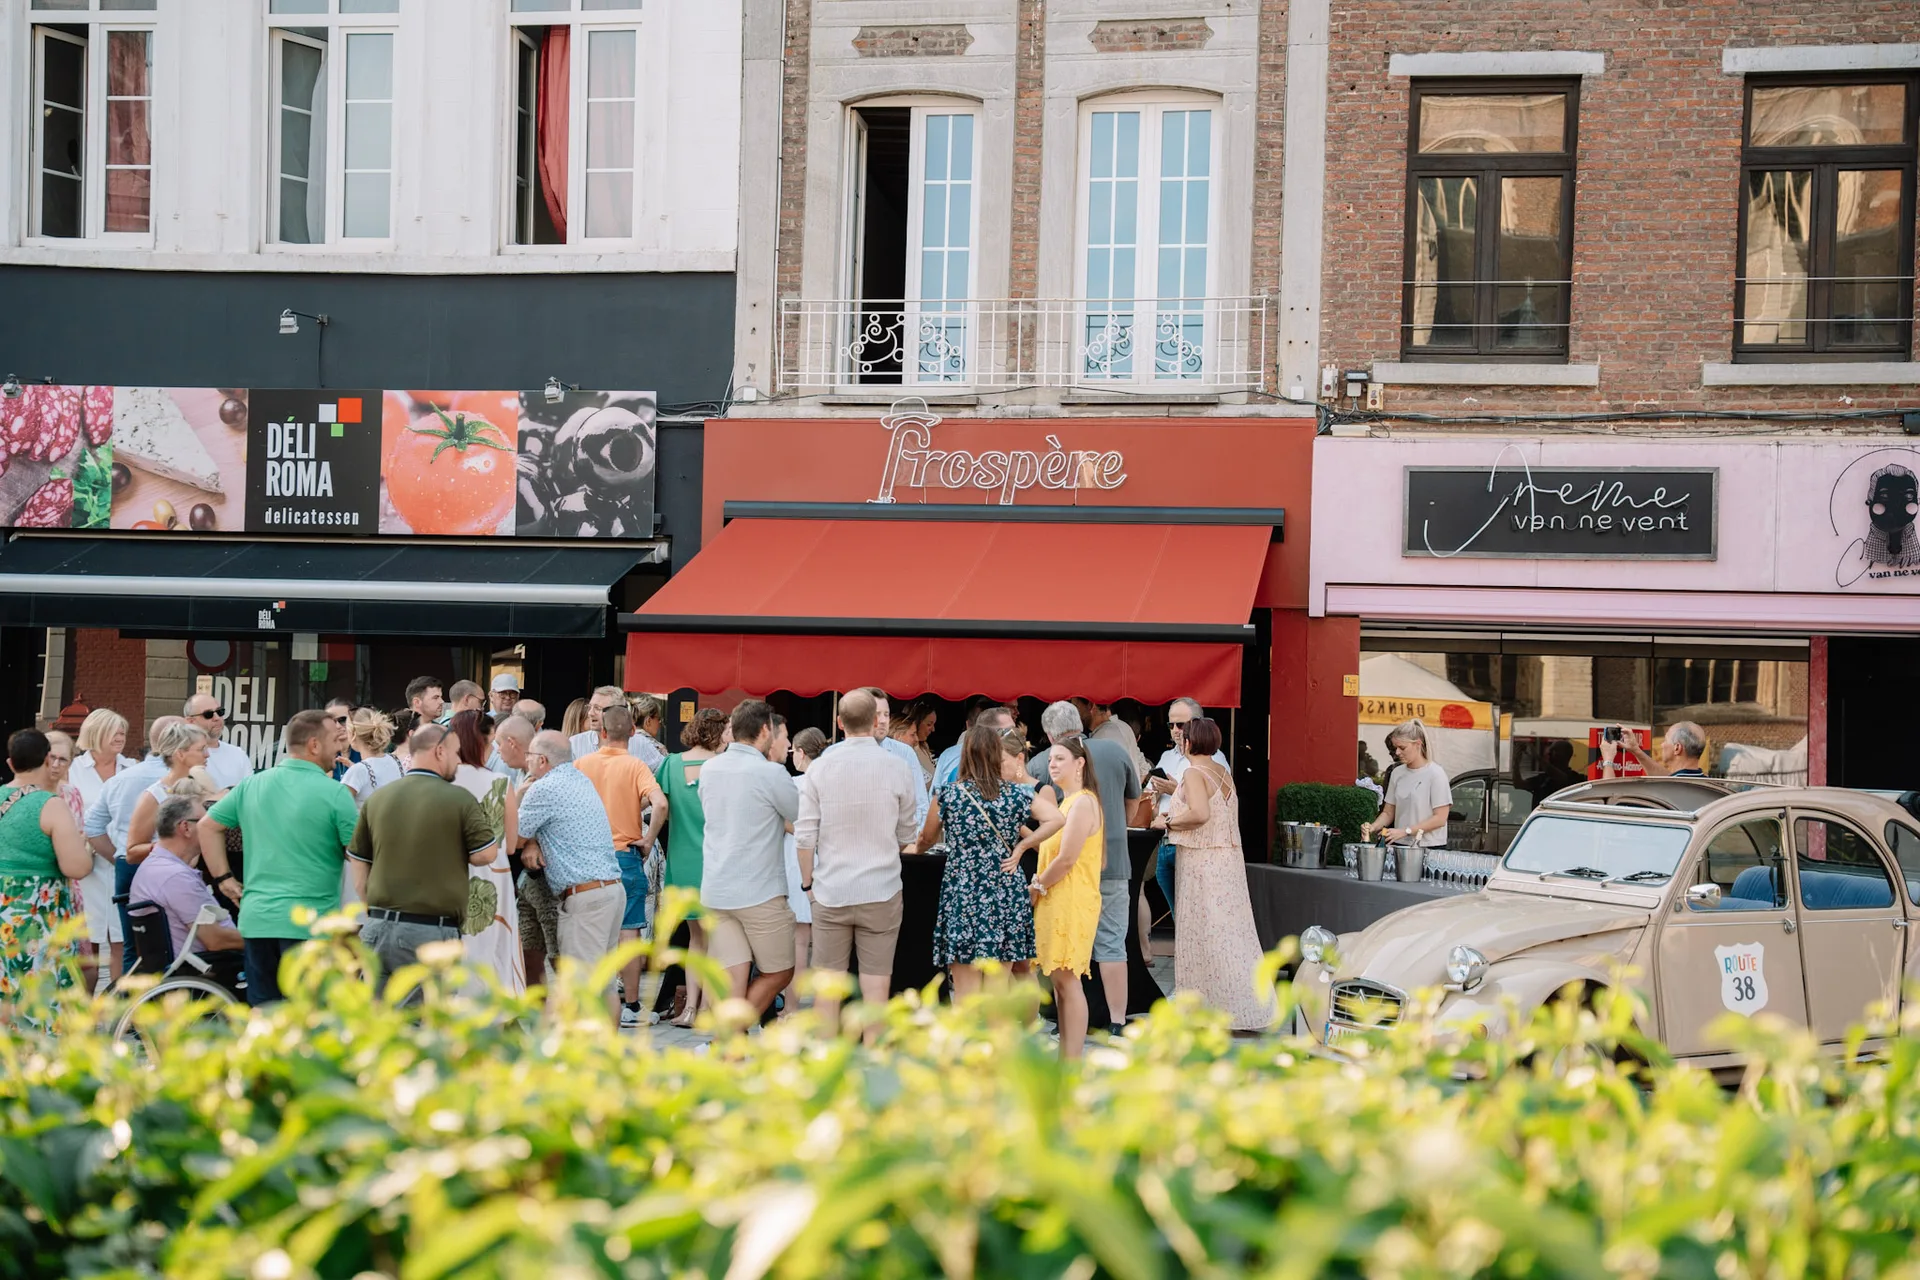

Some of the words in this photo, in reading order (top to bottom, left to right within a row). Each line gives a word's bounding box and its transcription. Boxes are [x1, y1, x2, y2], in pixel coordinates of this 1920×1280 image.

[267, 416, 316, 459] DÉLI
[266, 461, 333, 497] ROMA
[265, 507, 359, 525] delicatessen
[1515, 513, 1565, 532] van
[1580, 514, 1613, 530] ne
[1622, 512, 1689, 531] vent
[1869, 570, 1891, 579] van
[1893, 568, 1909, 577] ne
[214, 668, 276, 722] DÉLI
[1724, 953, 1757, 974] ROUTE
[1732, 975, 1756, 1002] 38
